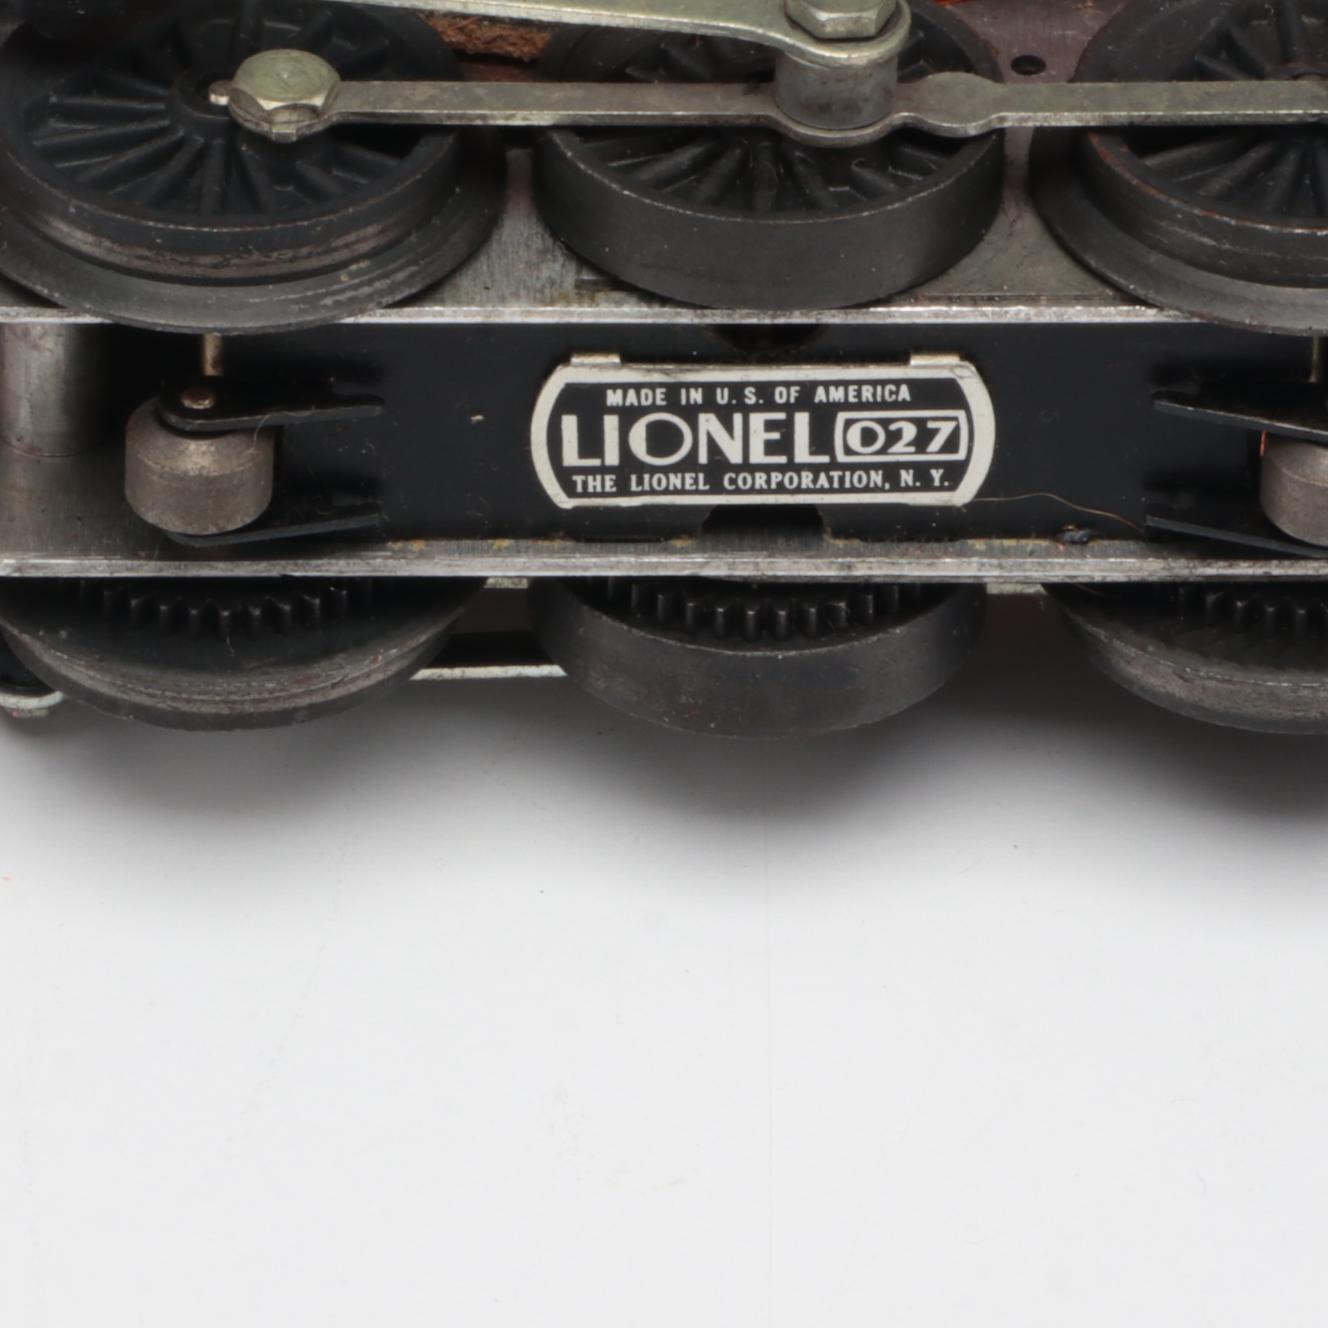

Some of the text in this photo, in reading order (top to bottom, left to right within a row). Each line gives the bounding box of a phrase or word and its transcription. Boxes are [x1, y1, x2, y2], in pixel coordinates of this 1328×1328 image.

[605, 387, 668, 407] MADE
[679, 387, 704, 406] IN
[774, 385, 801, 404] OF
[813, 383, 912, 403] AMERICA
[560, 411, 831, 468] LIONEL
[572, 474, 618, 494] THE
[629, 471, 711, 492] LIONEL
[722, 468, 891, 491] CORPORATION,
